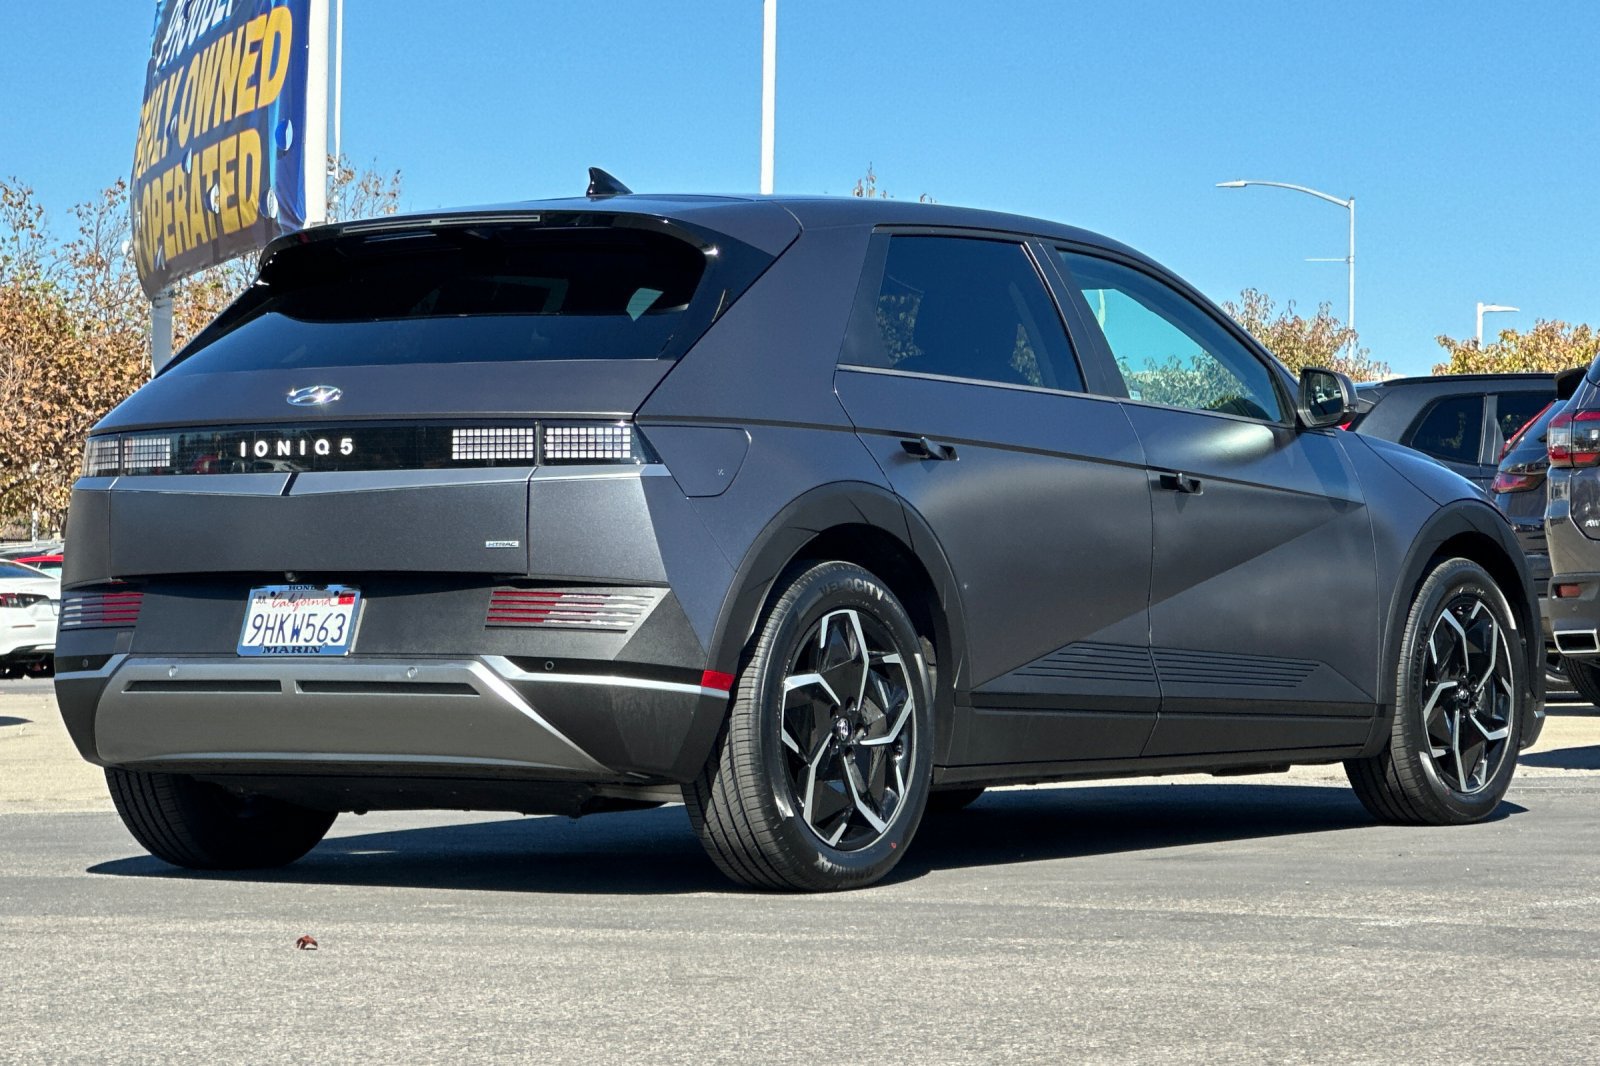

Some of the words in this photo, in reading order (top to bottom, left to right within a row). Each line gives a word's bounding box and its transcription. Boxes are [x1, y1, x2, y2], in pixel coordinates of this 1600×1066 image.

[179, 6, 293, 148] OWNED
[142, 128, 262, 272] OPERATED
[240, 438, 330, 458] IONIQ
[339, 438, 353, 456] 5
[1585, 519, 1600, 527] AW
[272, 592, 339, 612] California
[247, 613, 347, 644] 9HKW563
[262, 645, 321, 654] MARIN
